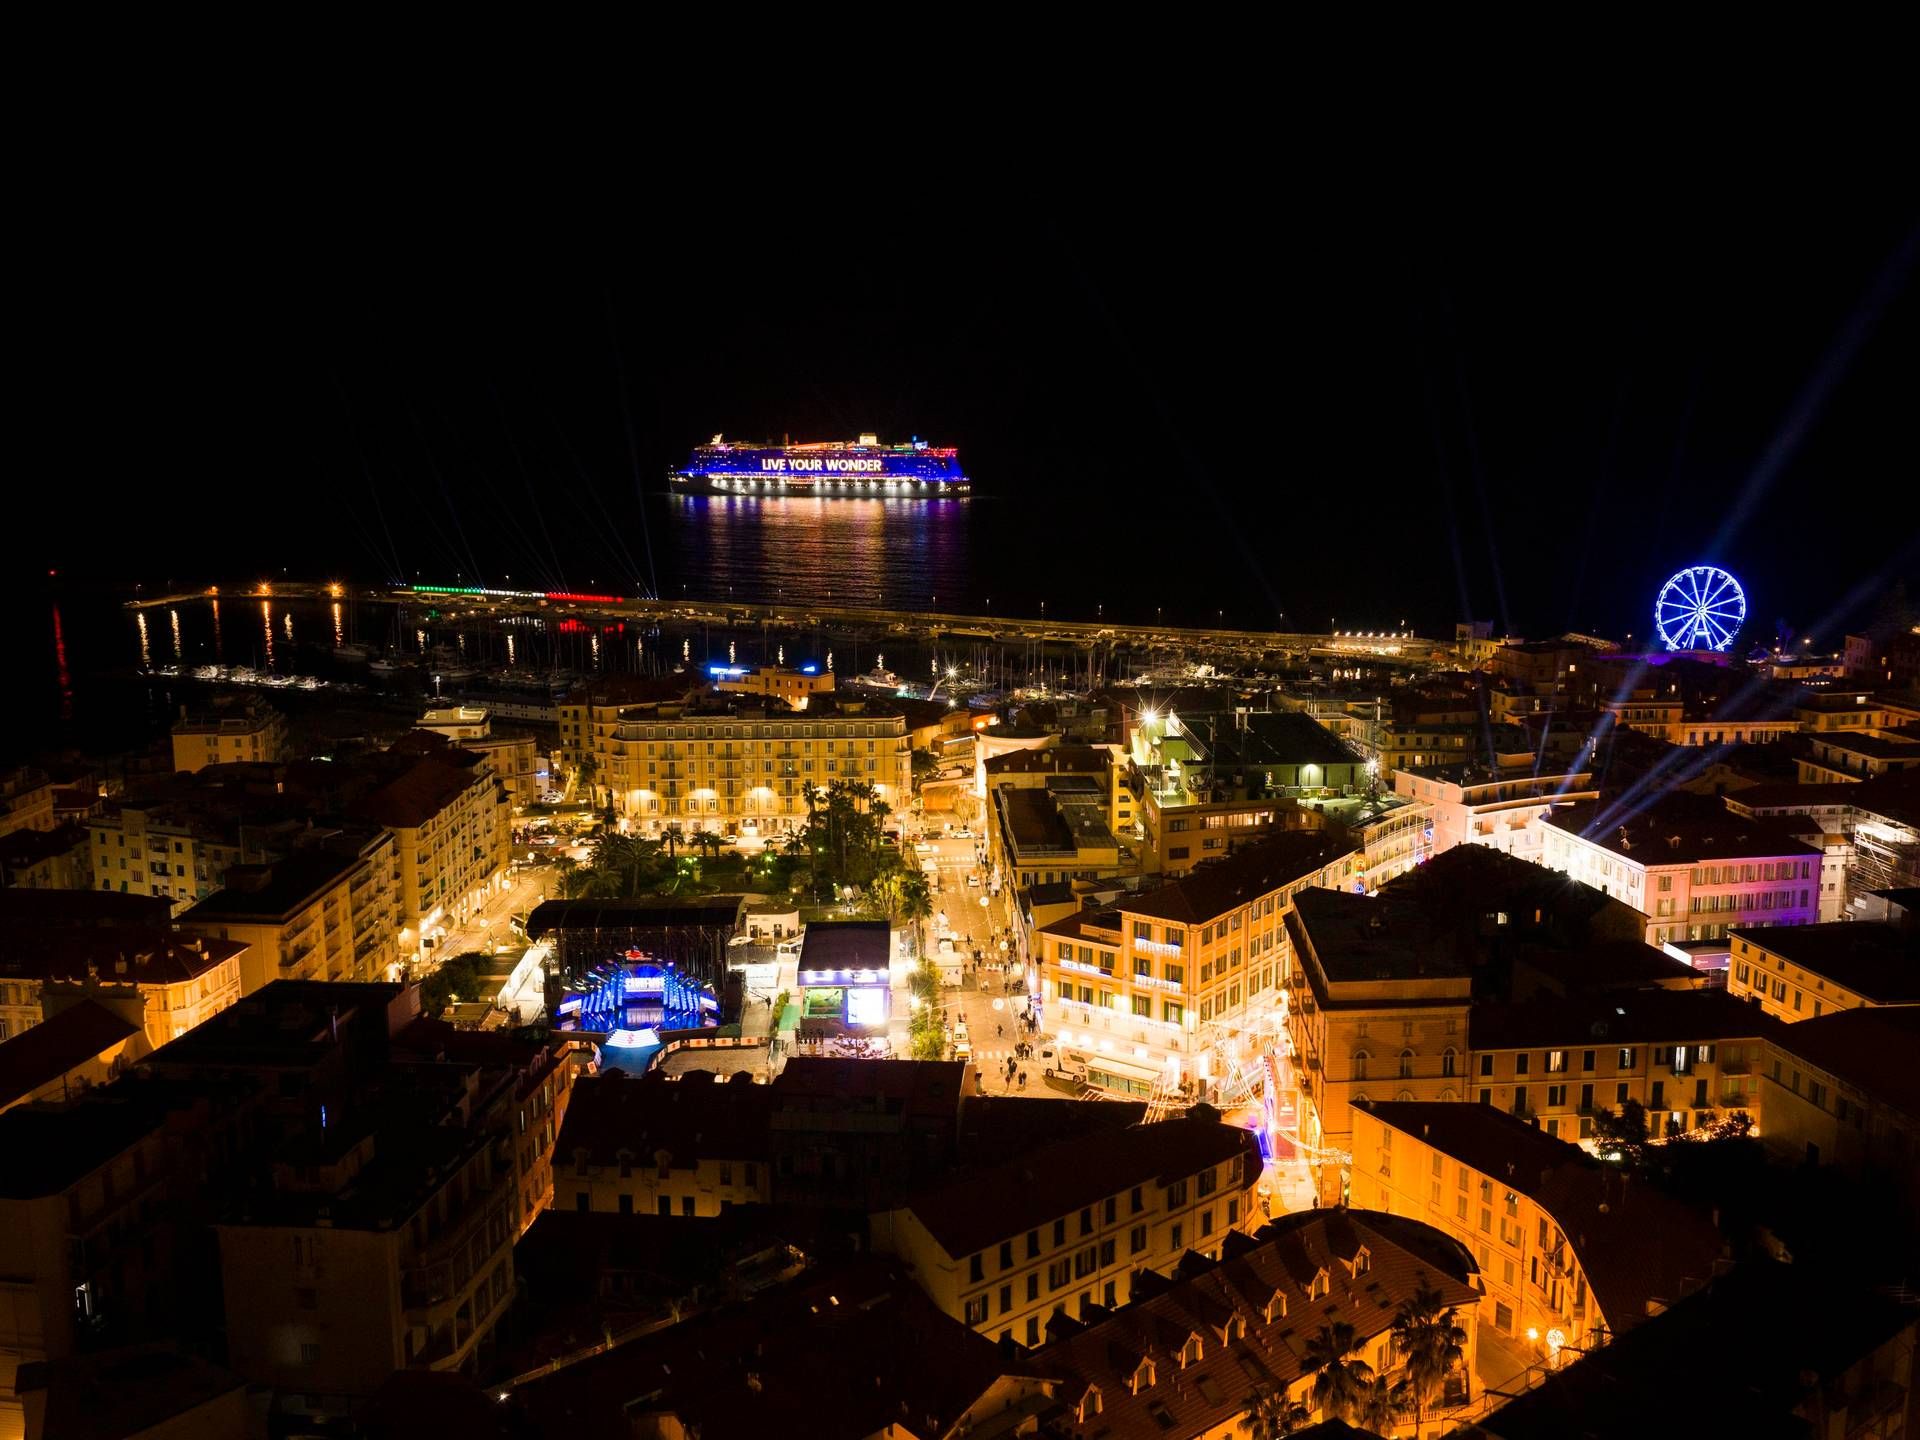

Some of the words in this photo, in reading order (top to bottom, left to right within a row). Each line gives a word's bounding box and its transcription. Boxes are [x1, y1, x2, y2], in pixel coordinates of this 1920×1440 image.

[762, 459, 786, 470] LIVE
[788, 459, 822, 471] YOUR
[826, 459, 882, 471] WONDER
